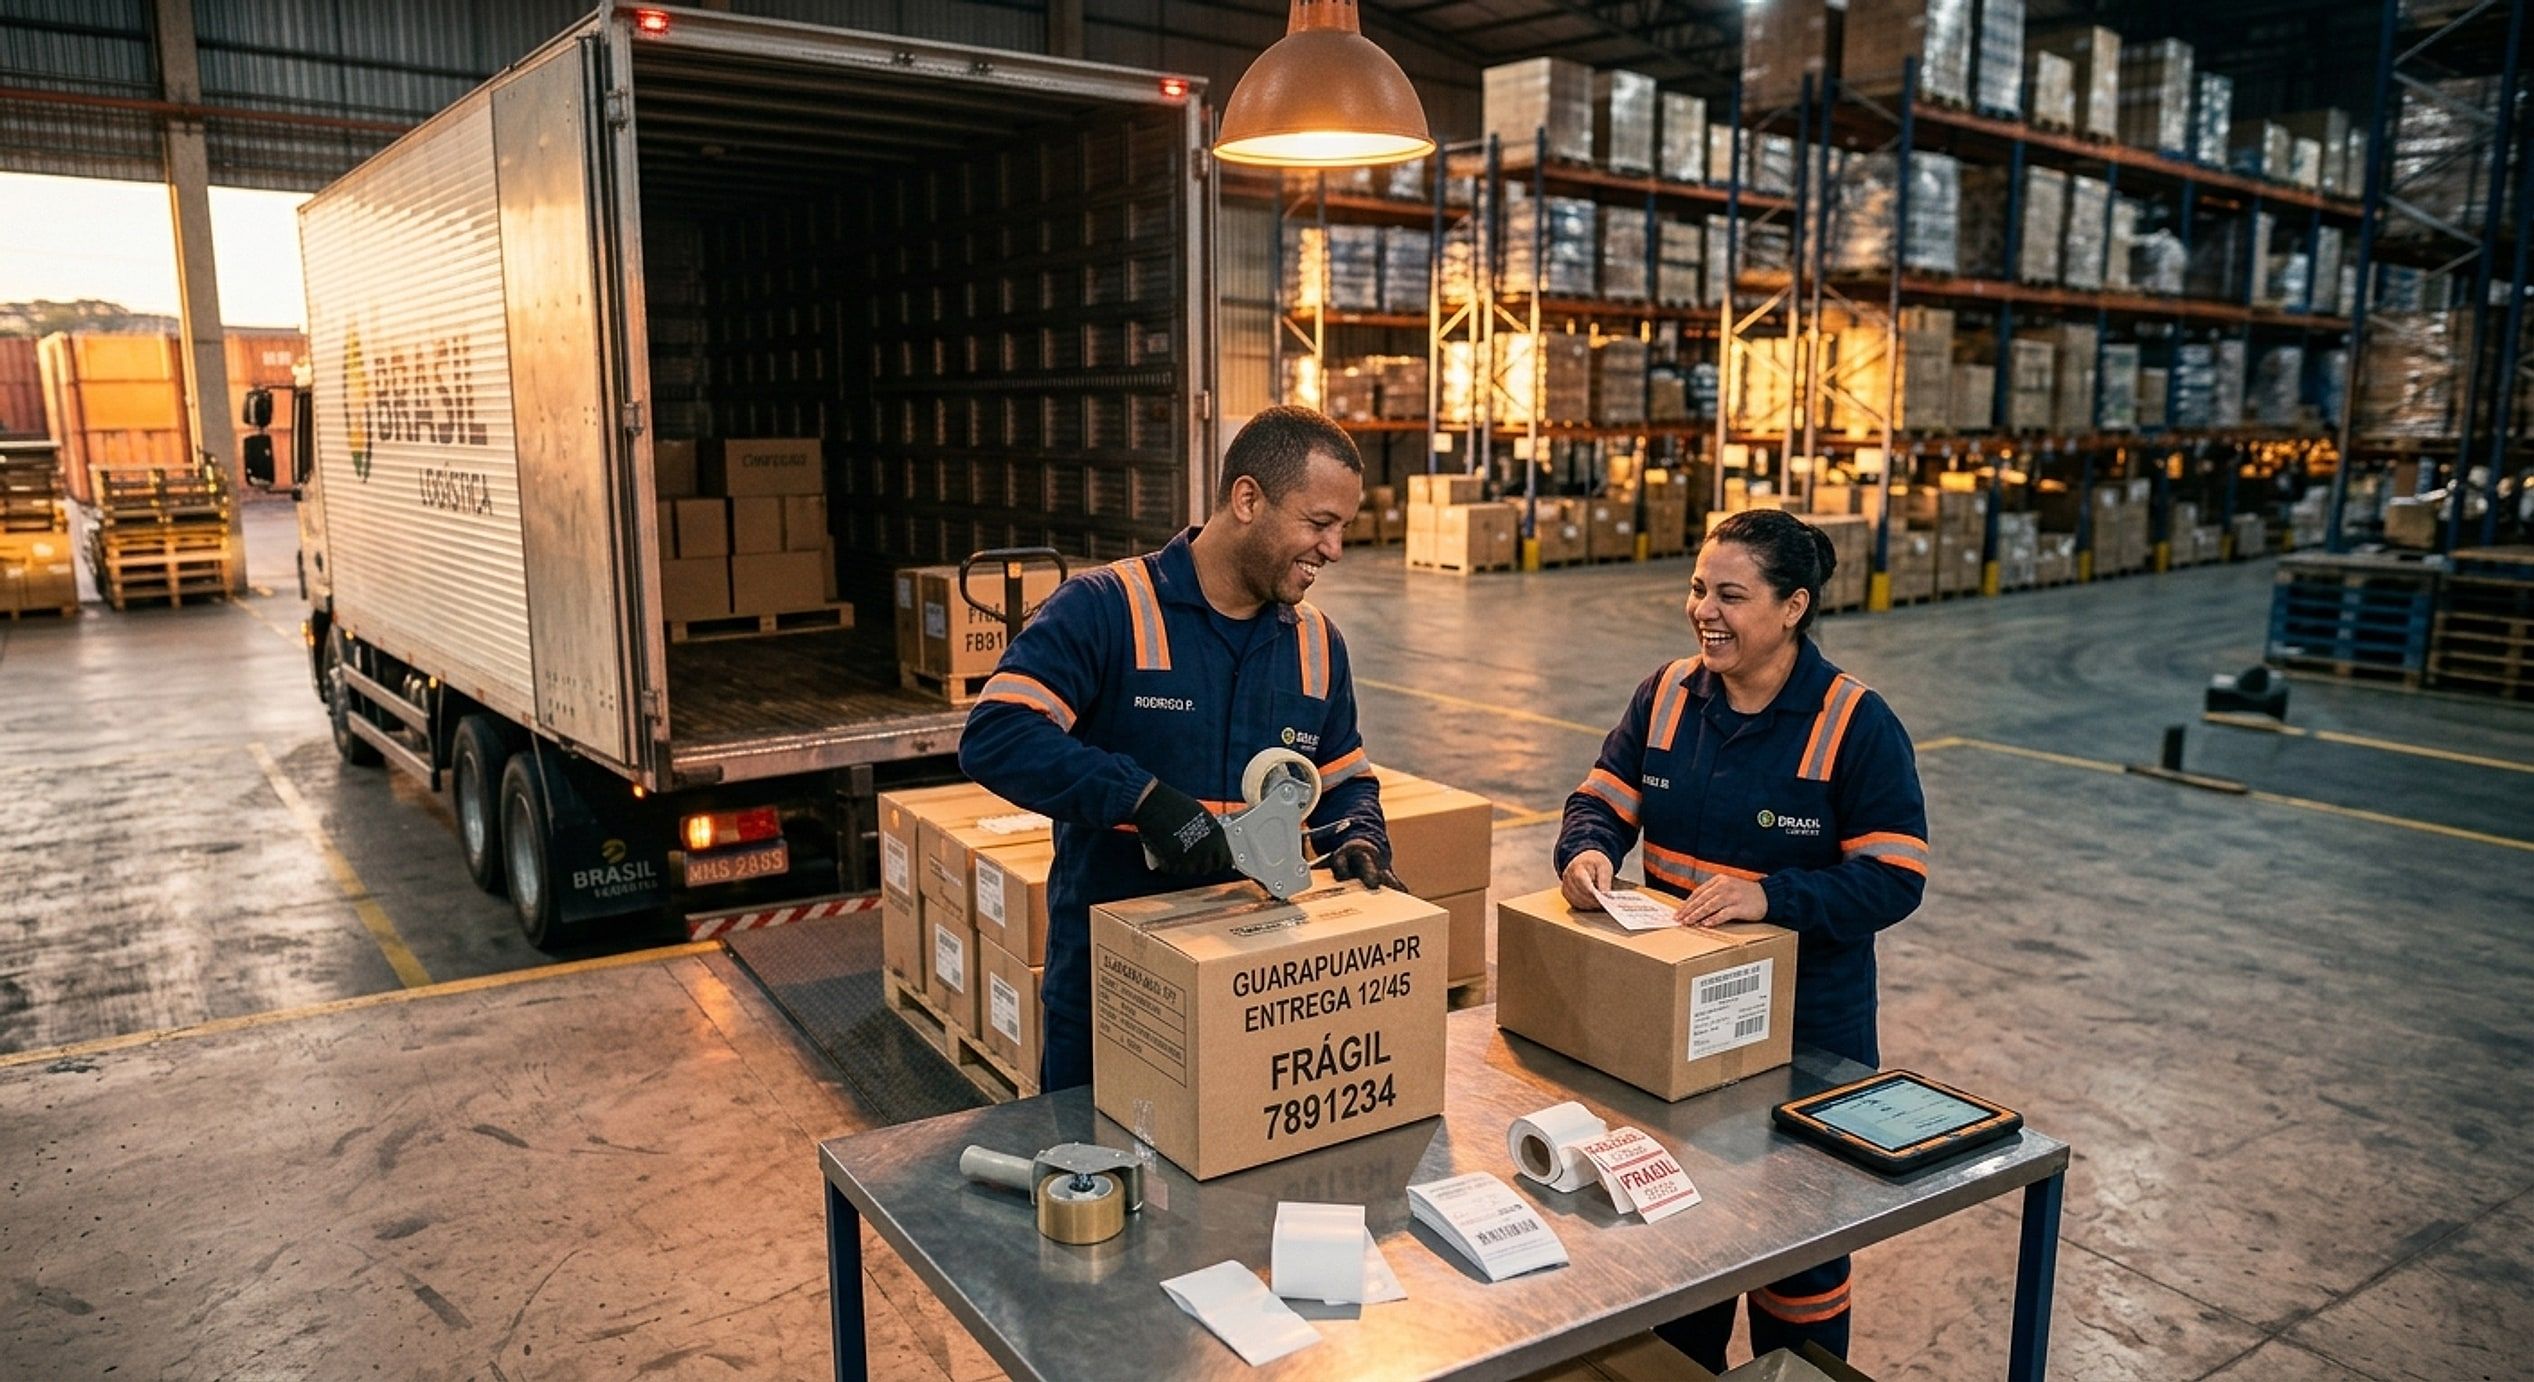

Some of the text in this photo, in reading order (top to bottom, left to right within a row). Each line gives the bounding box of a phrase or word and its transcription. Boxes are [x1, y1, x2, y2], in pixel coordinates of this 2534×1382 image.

[373, 333, 488, 446] BRASIL
[572, 860, 657, 889] BRASIL
[1232, 935, 1421, 998] GUARAPUAVA-PR
[1244, 972, 1411, 1033] ENTREGA 12/45
[1271, 1031, 1392, 1091] FRÁGIL
[1263, 1073, 1397, 1141] 7891234
